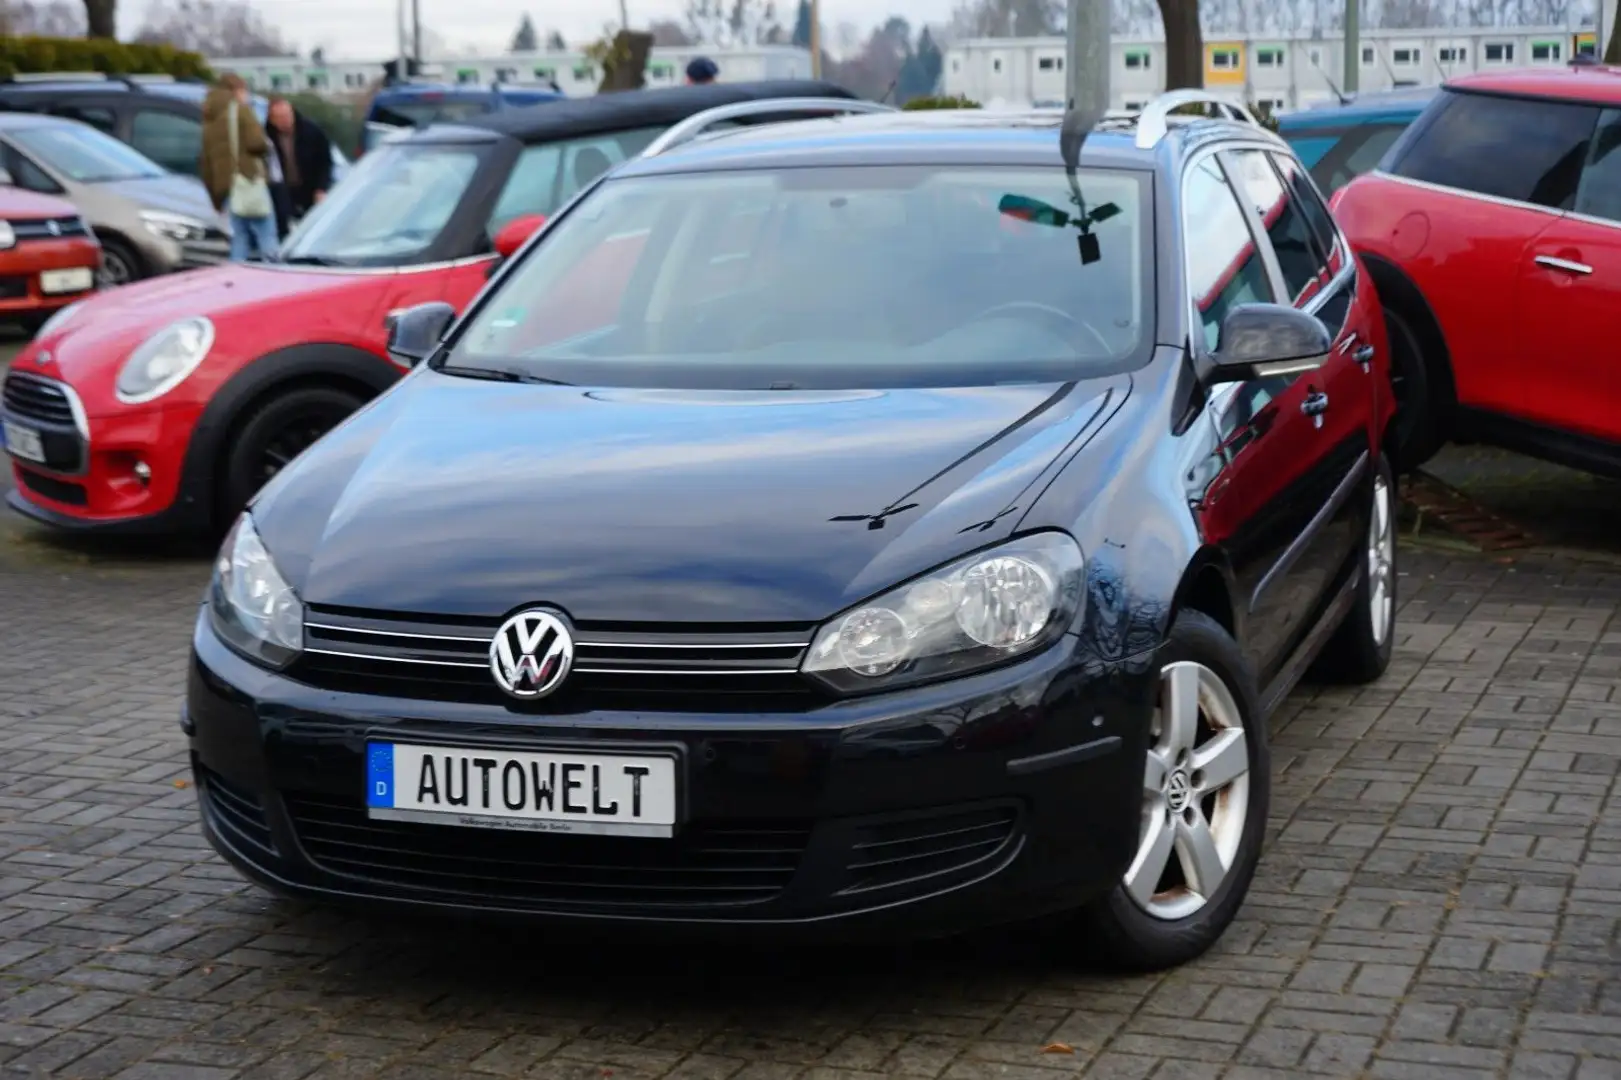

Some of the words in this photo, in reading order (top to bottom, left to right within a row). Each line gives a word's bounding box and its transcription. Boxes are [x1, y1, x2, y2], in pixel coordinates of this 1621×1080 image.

[491, 610, 570, 695] VW
[376, 781, 387, 796] D
[417, 754, 649, 817] AUTOWELT
